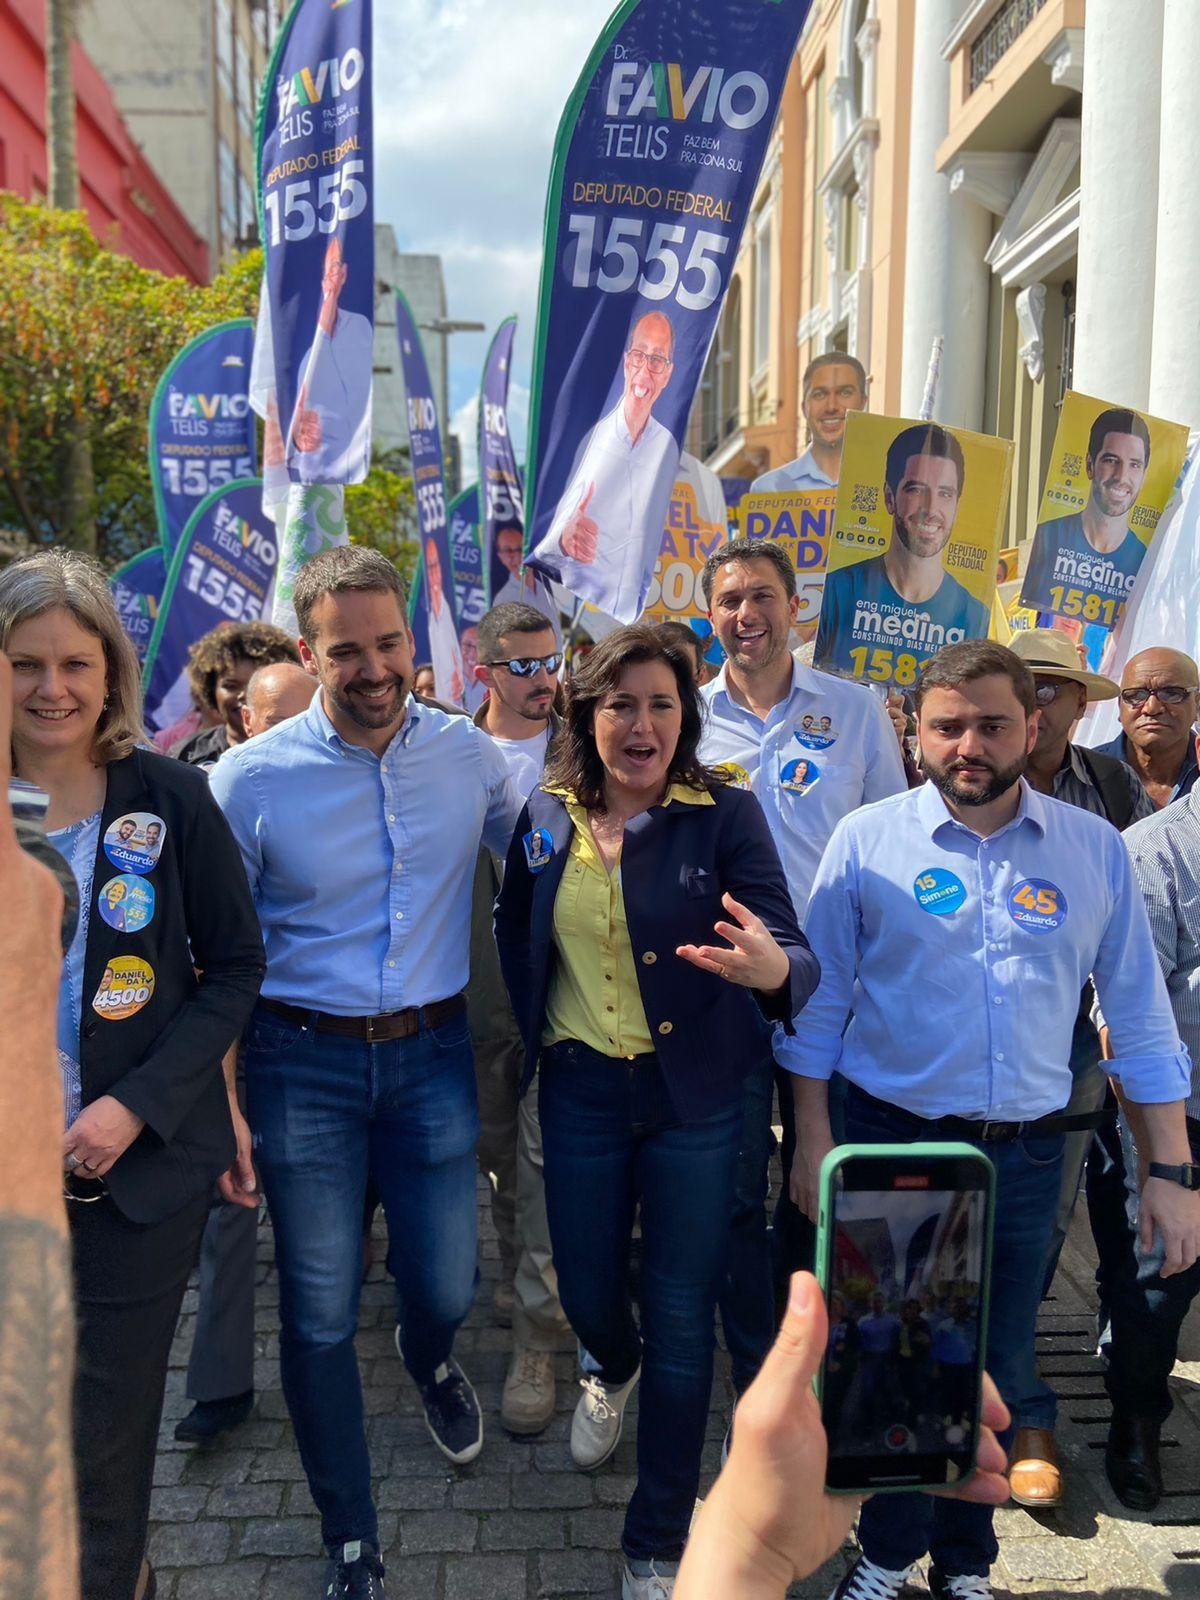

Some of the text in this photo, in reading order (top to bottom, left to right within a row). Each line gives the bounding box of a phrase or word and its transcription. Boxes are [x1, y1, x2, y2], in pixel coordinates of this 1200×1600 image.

[614, 44, 629, 60] Dr.
[277, 47, 364, 123] FAVIO
[605, 62, 770, 130] FAVIO
[604, 123, 670, 161] TELIS
[683, 134, 720, 150] FAZ BEM
[680, 152, 743, 173] PRA ZONA SUL
[265, 160, 367, 247] 1555
[573, 182, 733, 223] DEPUTADO FEDERAL
[568, 213, 730, 311] 1555
[168, 392, 250, 419] FAVIO
[170, 418, 208, 437] TELIS
[672, 488, 690, 499] RAL
[748, 498, 812, 510] DEPUTADO
[669, 500, 700, 531] EL
[212, 526, 243, 559] TELIS
[213, 506, 276, 568] FAVIO
[948, 542, 988, 561] DEPUTADO
[1058, 547, 1076, 559] eng
[946, 554, 985, 572] ESTADUAL
[856, 599, 917, 618] eng miguel
[853, 609, 966, 645] medina
[1008, 615, 1031, 631] ANIEL
[852, 630, 942, 655] CONSTRUINDO DIAS MEL
[849, 646, 930, 686] 158
[110, 848, 155, 867] Eduardo
[916, 874, 937, 891] 15
[919, 884, 959, 905] Simone
[1013, 884, 1058, 915] 45
[1013, 910, 1058, 927] Eduardo
[114, 970, 147, 980] DANIEL
[94, 986, 150, 1009] 4500
